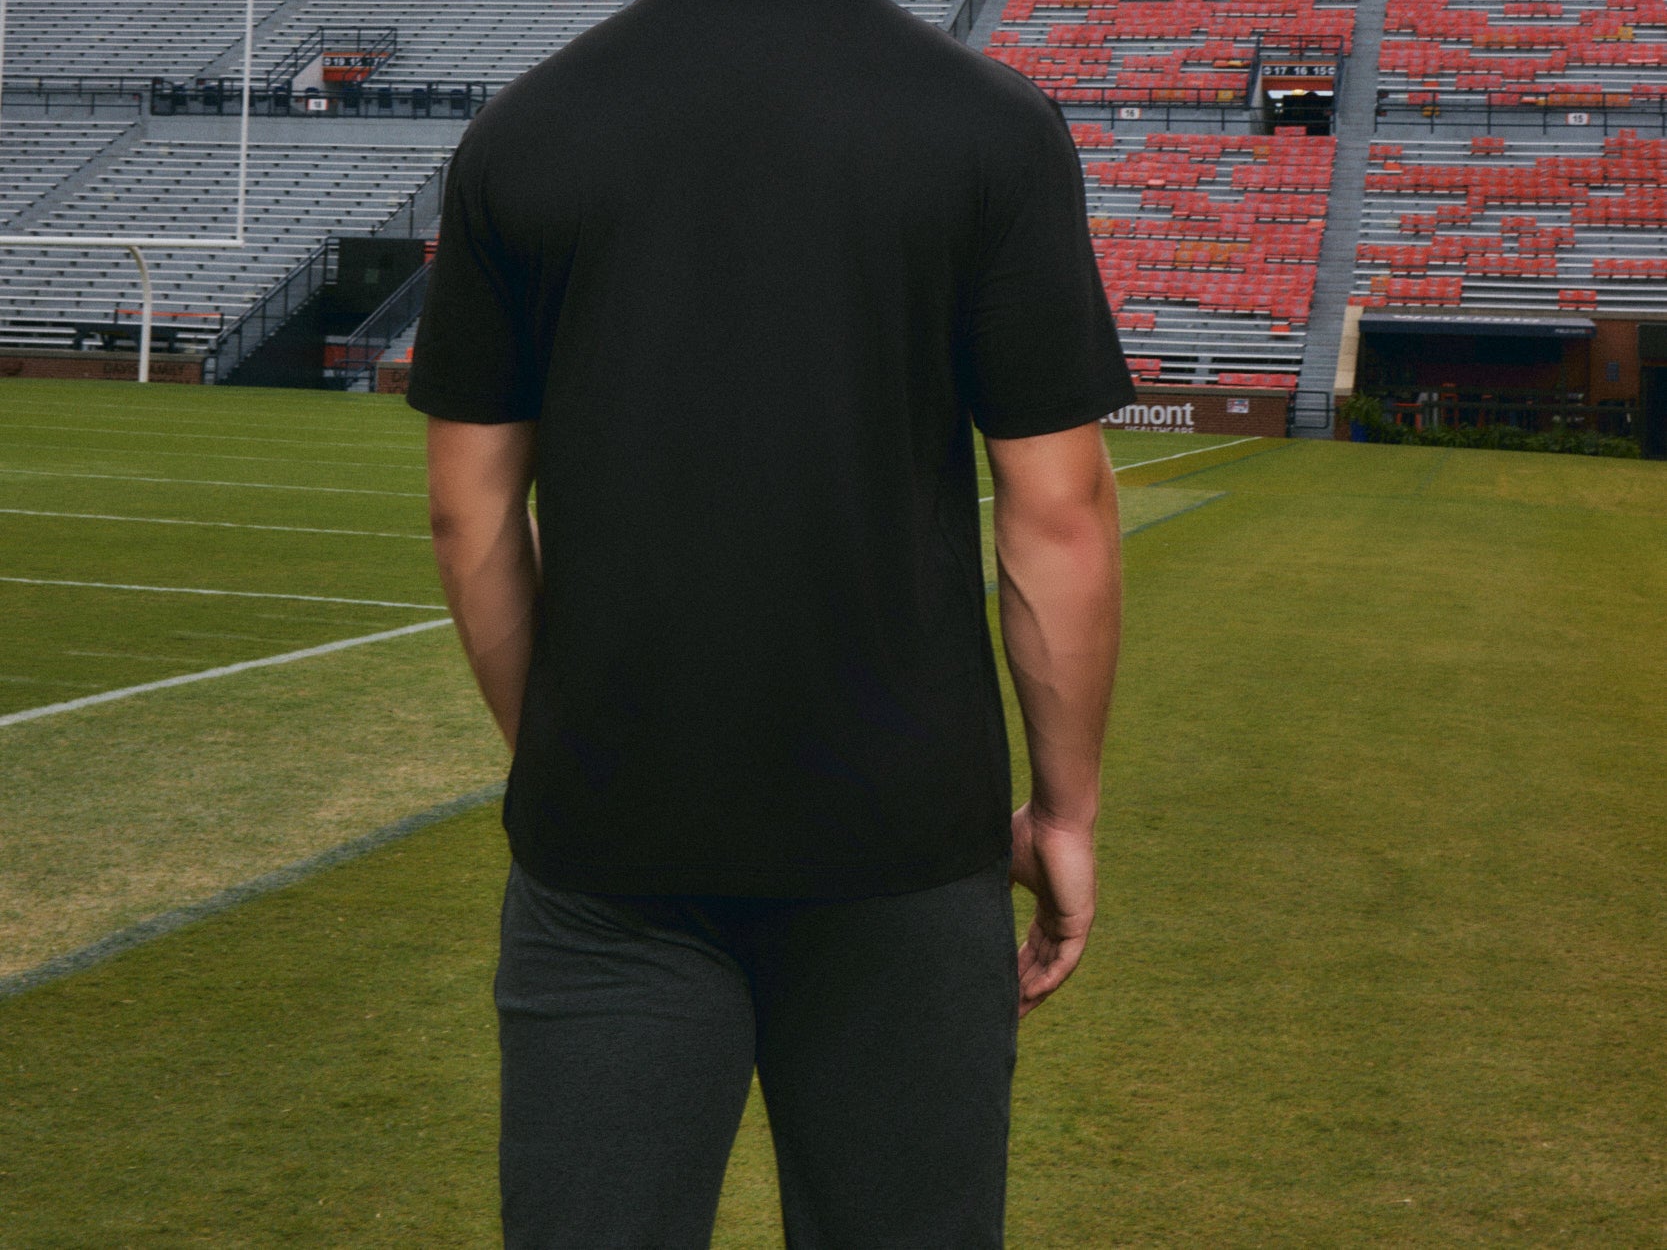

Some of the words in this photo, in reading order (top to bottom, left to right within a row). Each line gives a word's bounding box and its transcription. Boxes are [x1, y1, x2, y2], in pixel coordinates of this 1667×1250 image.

[1274, 66, 1288, 75] 17
[1294, 66, 1308, 75] 16
[1313, 66, 1327, 75] 15
